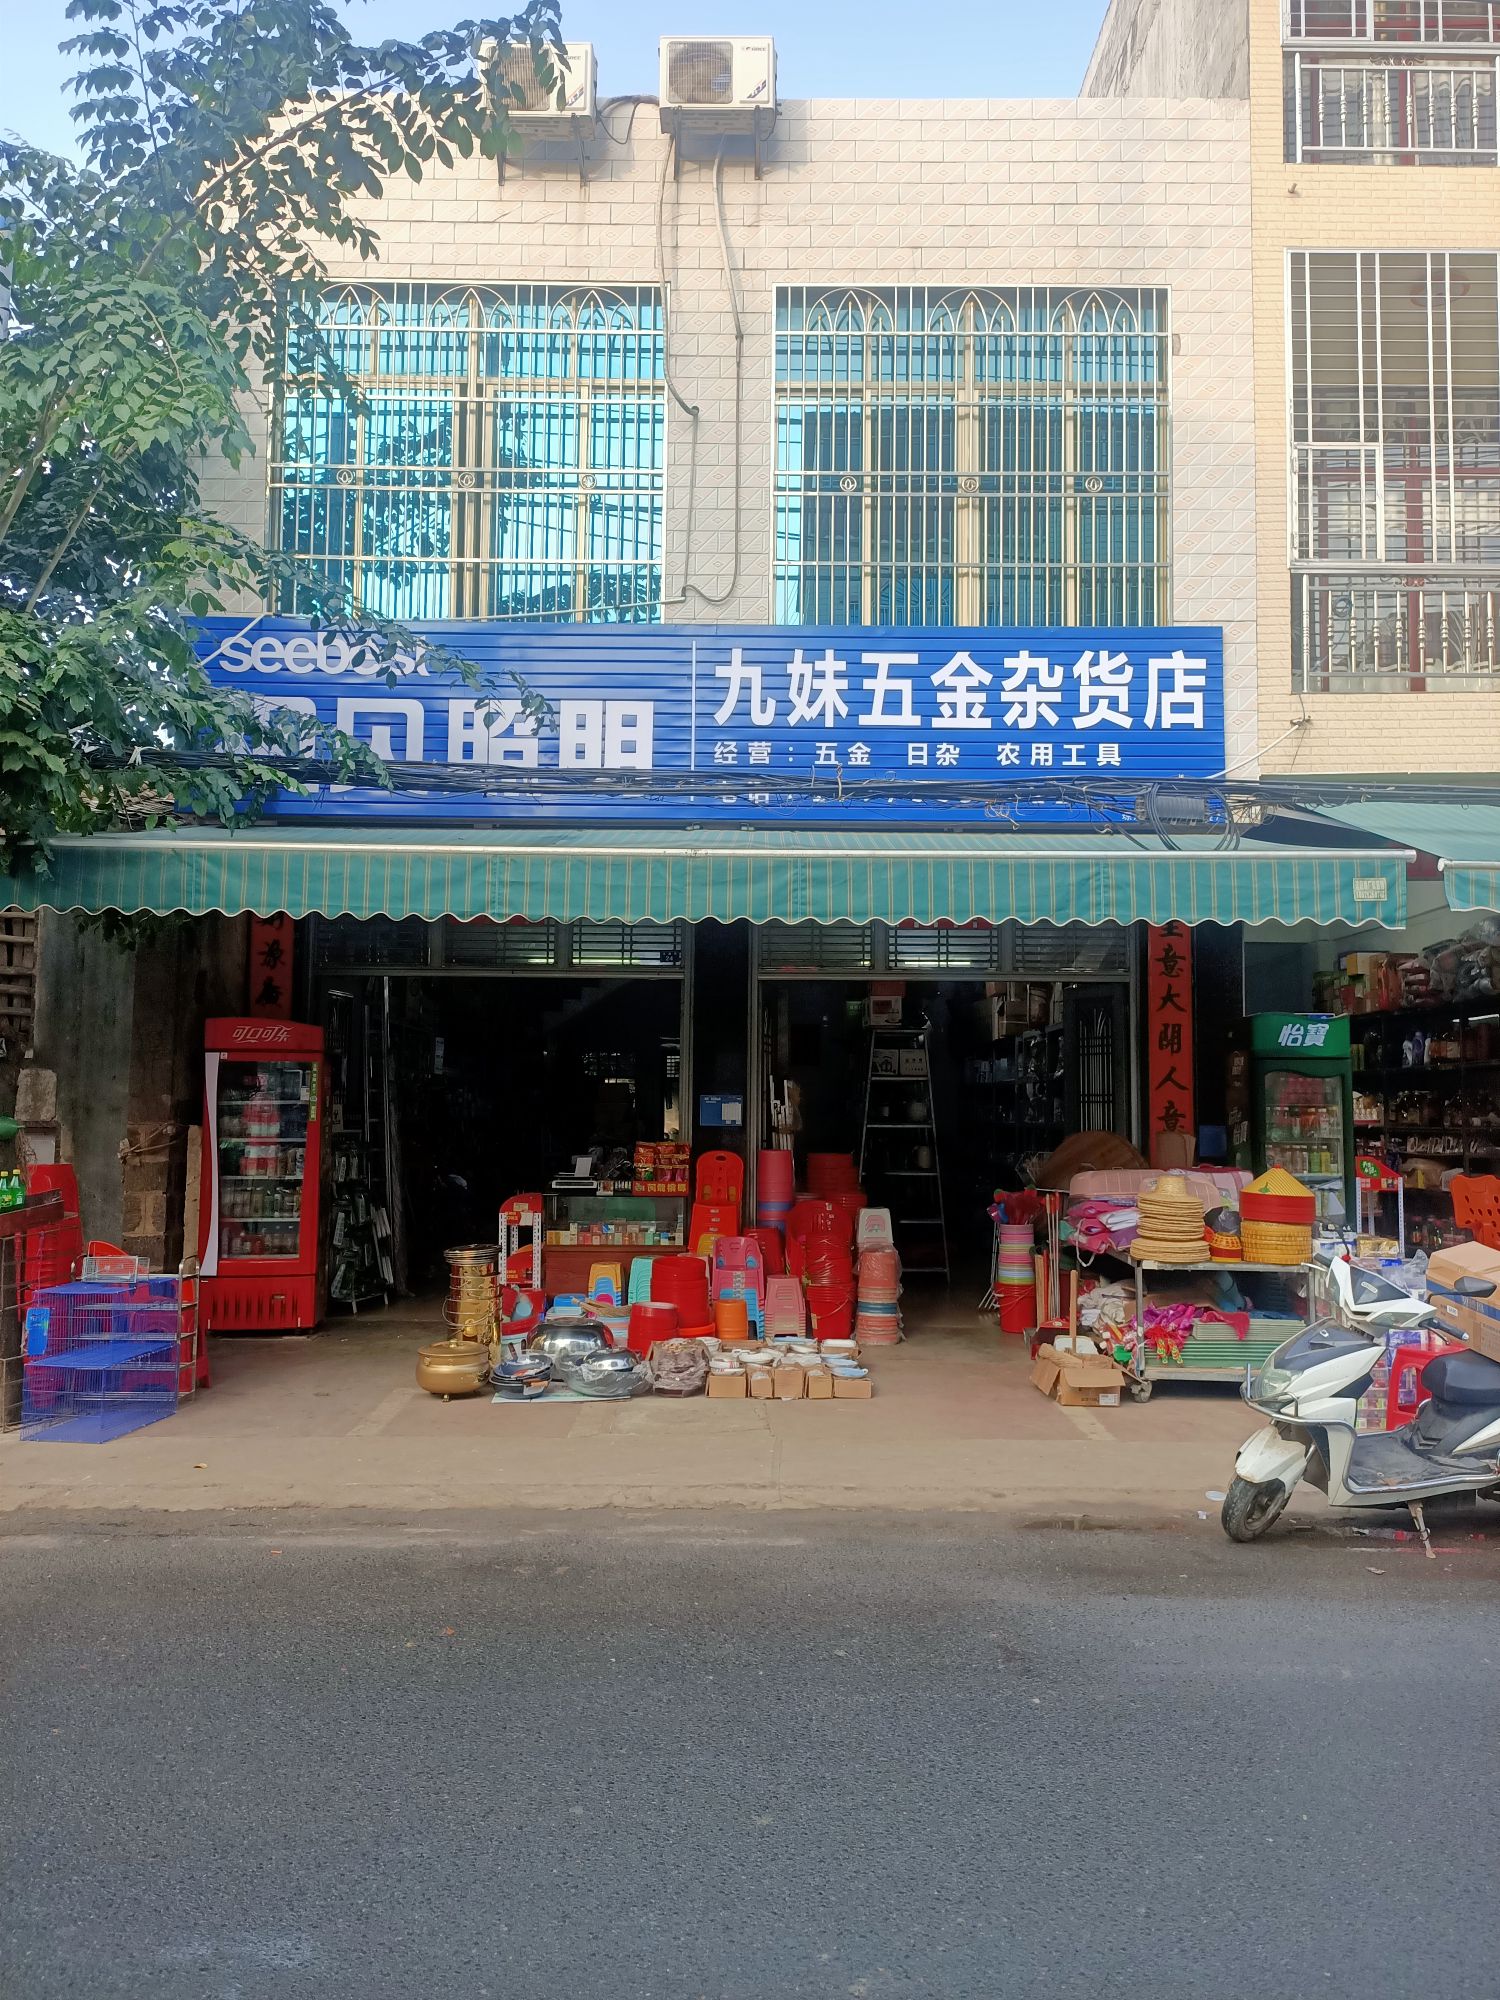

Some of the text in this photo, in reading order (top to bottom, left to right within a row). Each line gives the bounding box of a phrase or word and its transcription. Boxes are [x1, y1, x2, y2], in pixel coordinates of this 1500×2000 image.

[713, 648, 1207, 730] 九妹五金杂货店
[995, 742, 1122, 768] 农用工具
[232, 1025, 294, 1043] 可口可乐
